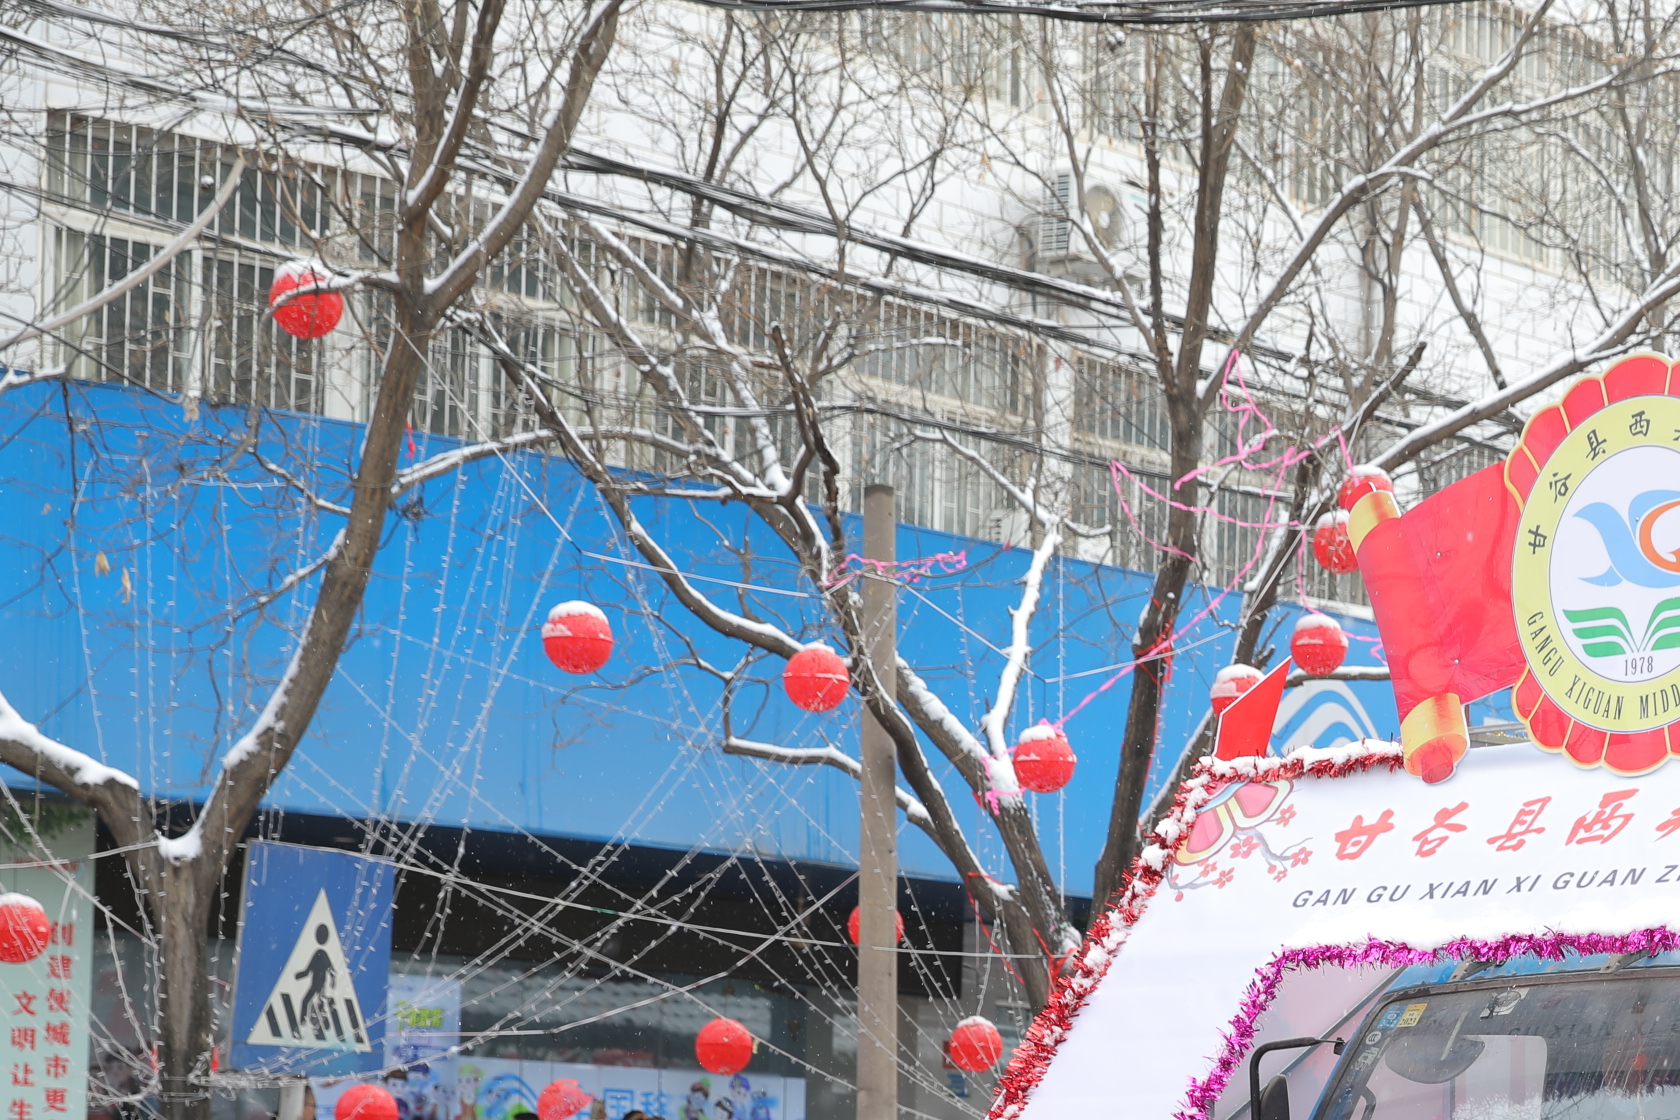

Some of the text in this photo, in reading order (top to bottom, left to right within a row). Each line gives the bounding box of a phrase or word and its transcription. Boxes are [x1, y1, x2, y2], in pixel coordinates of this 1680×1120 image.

[1526, 610, 1566, 677] GANGU
[1564, 675, 1625, 721] XIGUAN
[1623, 657, 1654, 677] 1978
[1291, 886, 1356, 908] GAN
[1366, 884, 1411, 904] GU
[1418, 878, 1498, 902] XIAN
[1506, 874, 1541, 894] XI
[1552, 867, 1646, 891] GUAN
